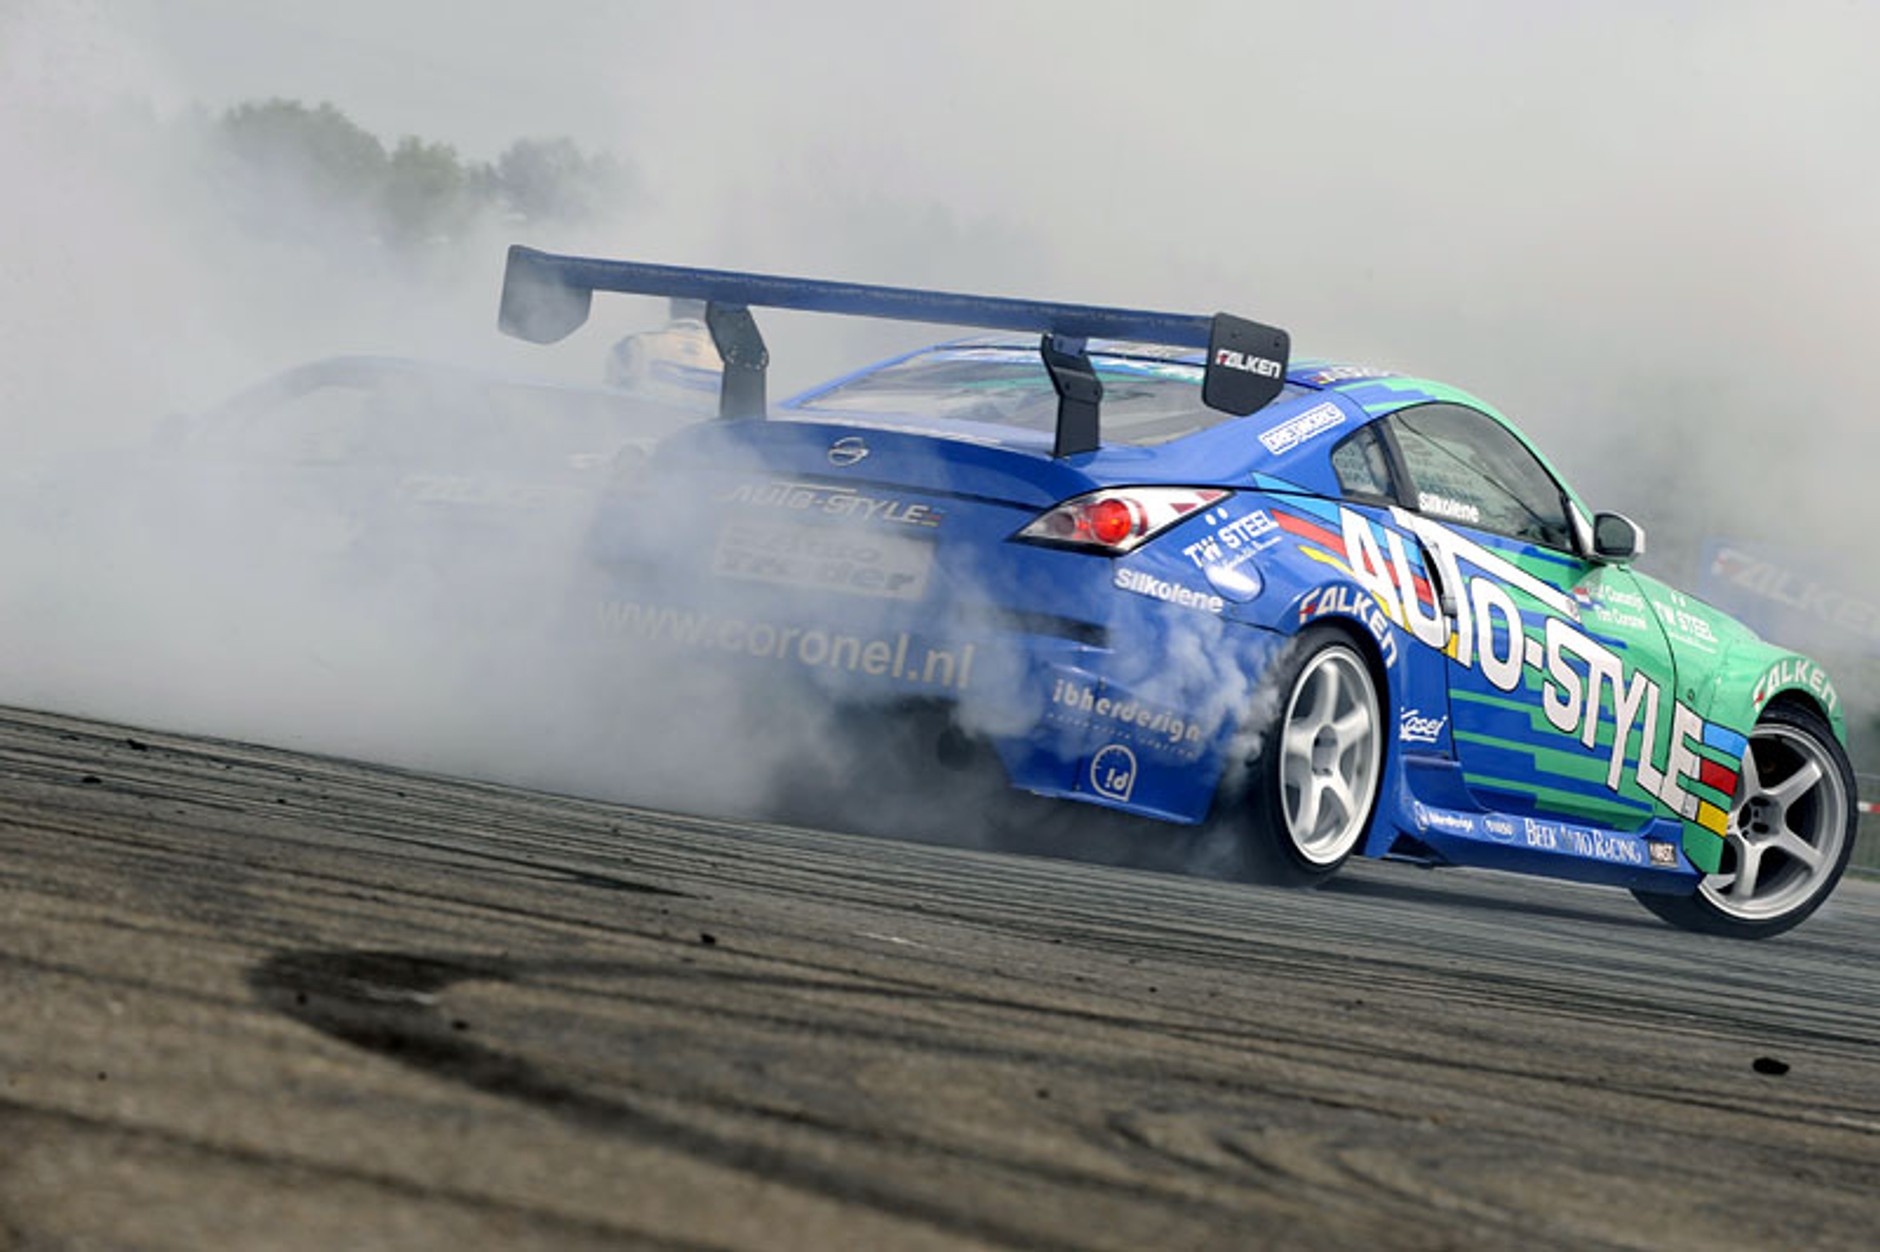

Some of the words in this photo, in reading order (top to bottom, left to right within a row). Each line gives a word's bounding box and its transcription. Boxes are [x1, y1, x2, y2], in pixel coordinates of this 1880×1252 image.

[1216, 349, 1282, 379] FALKEN
[1418, 492, 1480, 523] Silkolene
[1183, 535, 1223, 568] TW
[1217, 509, 1280, 549] STEEL
[1113, 568, 1225, 612] Silkolene
[597, 601, 975, 688] www.coronel.nl
[1299, 585, 1398, 669] FALKEN
[1676, 609, 1718, 643] STEEL
[1339, 505, 1702, 821] AUTO-STYLE
[1753, 659, 1838, 713] FALKEN
[1052, 678, 1202, 742] ibherdesign
